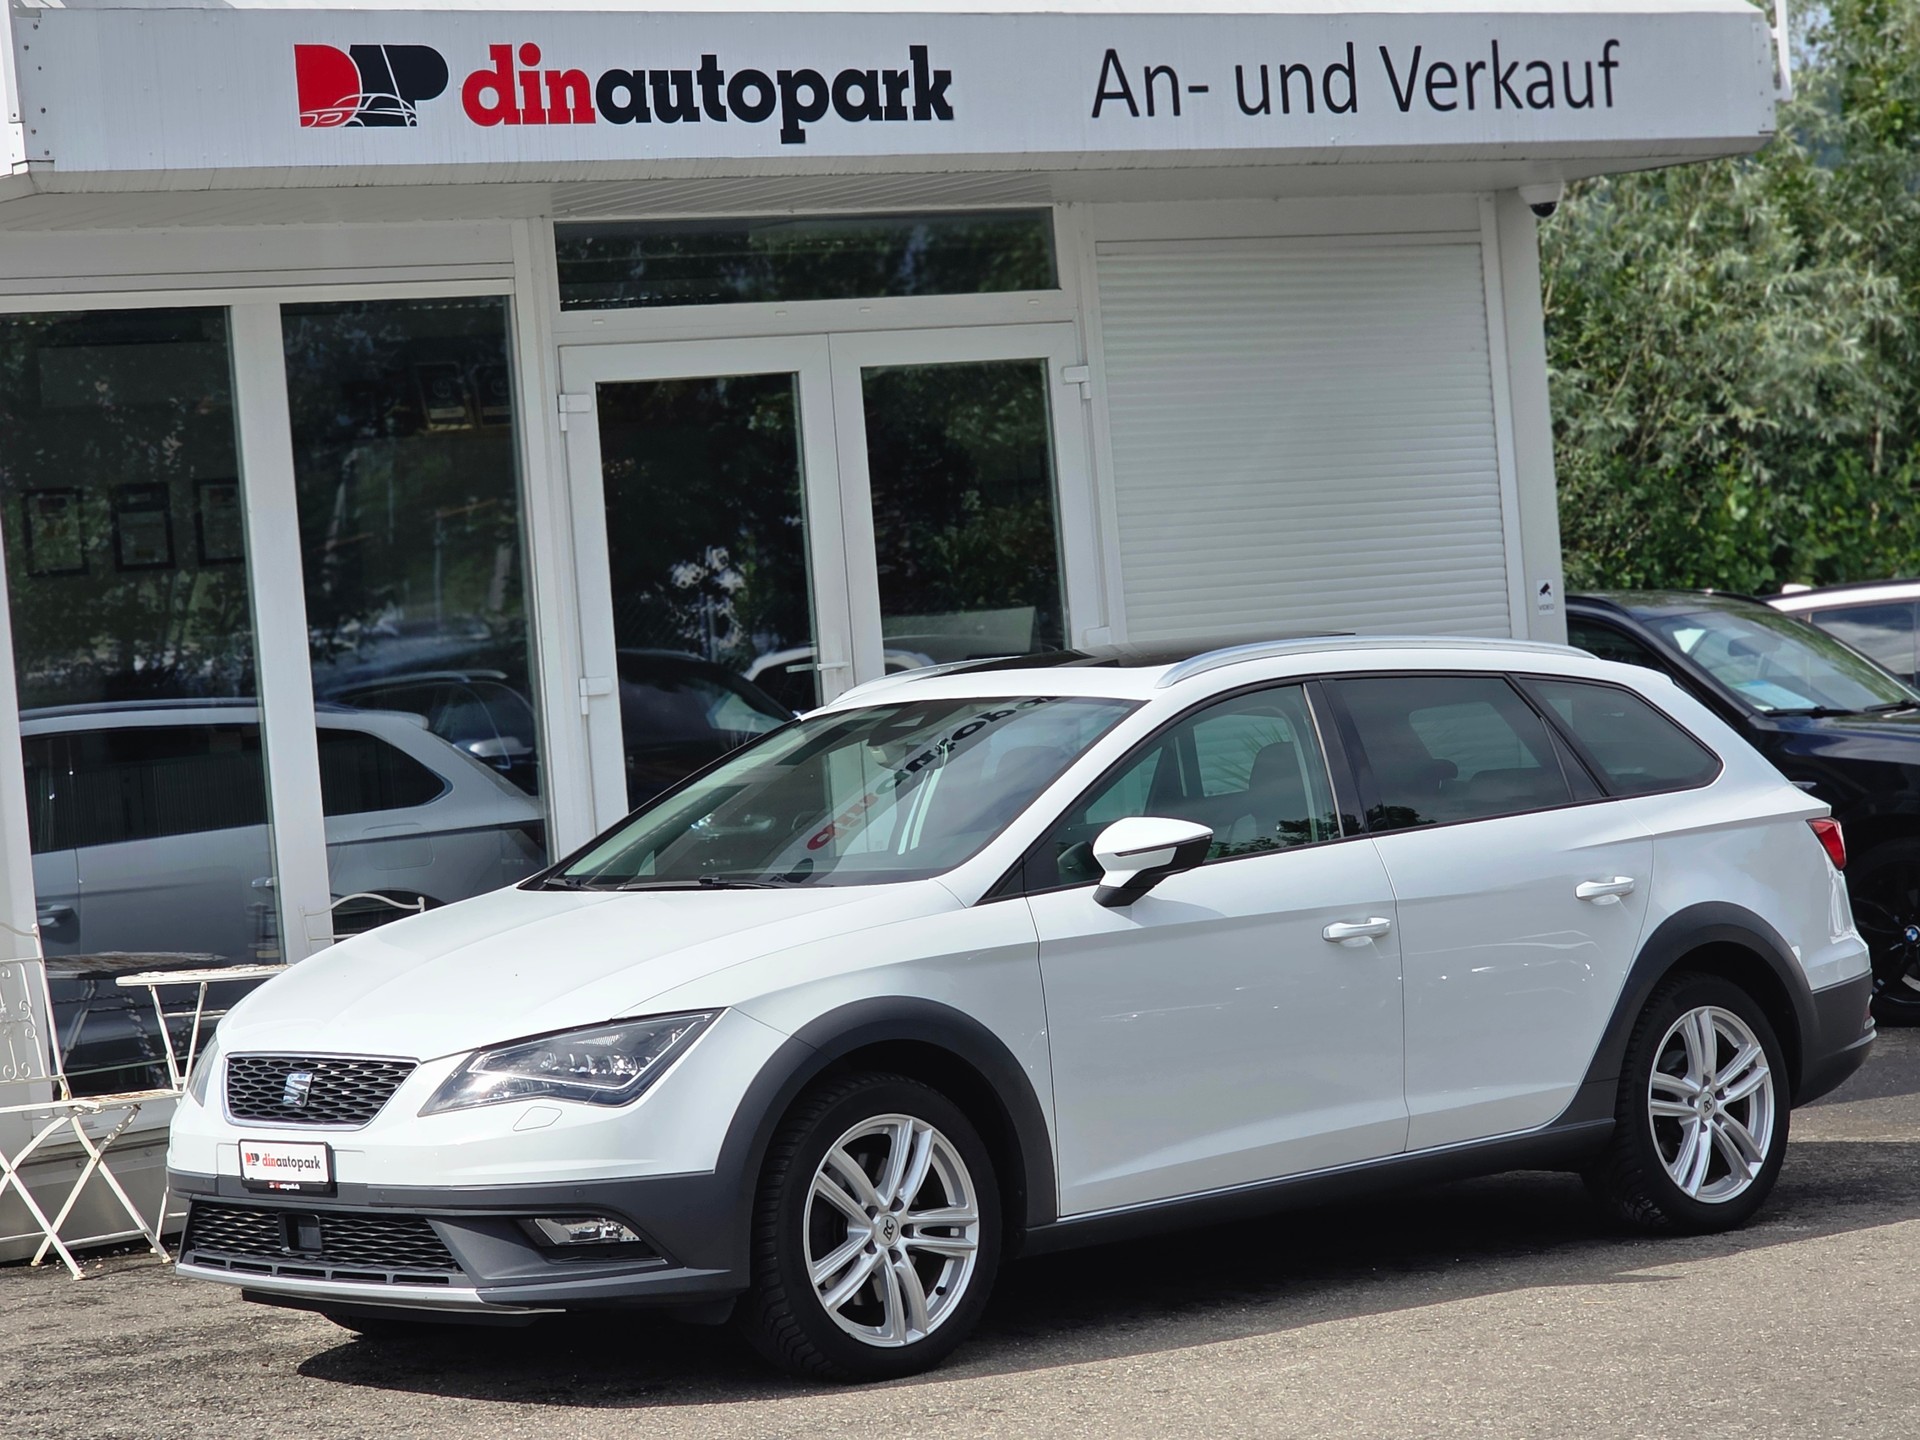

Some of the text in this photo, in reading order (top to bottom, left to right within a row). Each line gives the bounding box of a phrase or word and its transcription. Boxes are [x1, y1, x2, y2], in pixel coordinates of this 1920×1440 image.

[461, 42, 954, 144] dinautopark
[1091, 39, 1620, 118] An- und Verkauf
[262, 1153, 321, 1172] dinautopark
